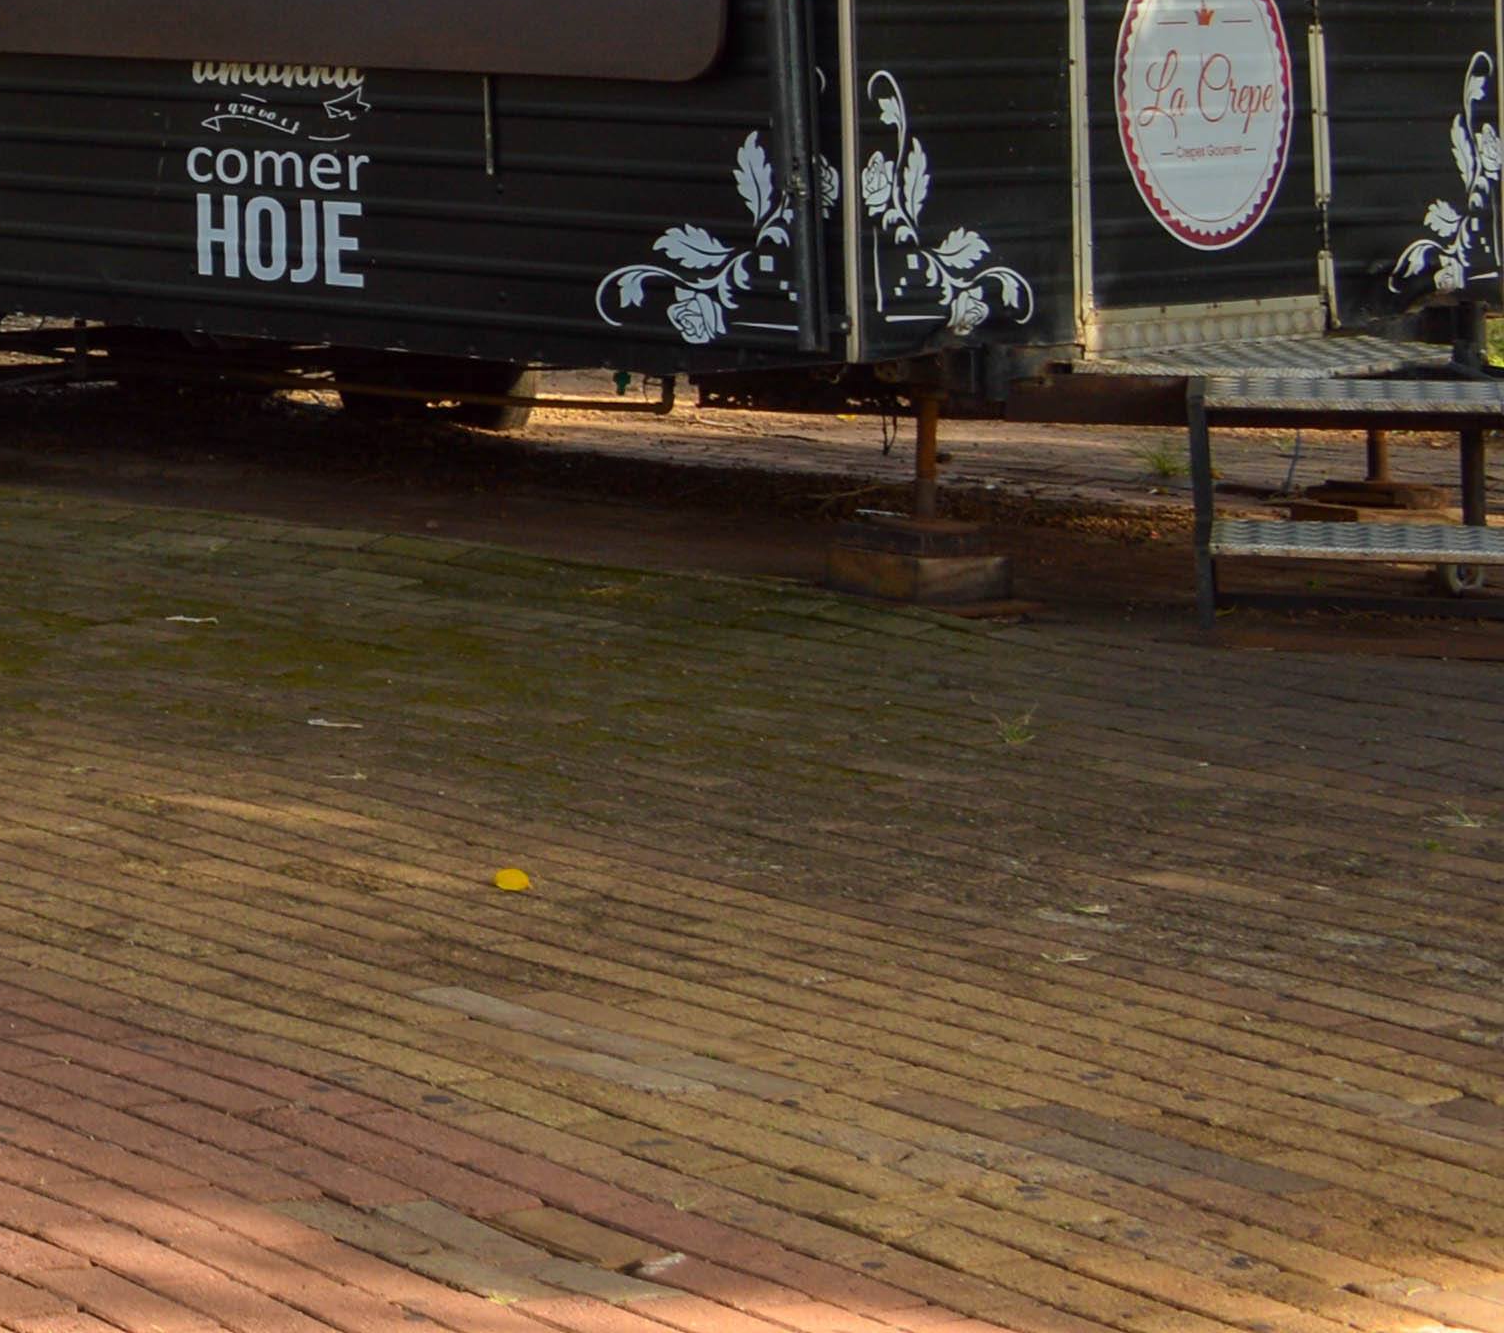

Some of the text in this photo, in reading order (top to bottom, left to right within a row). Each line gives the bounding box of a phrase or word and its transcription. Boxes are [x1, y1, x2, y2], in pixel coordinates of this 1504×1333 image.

[1138, 50, 1273, 139] La Crepe
[187, 146, 370, 191] comer
[196, 193, 365, 289] HOJE
